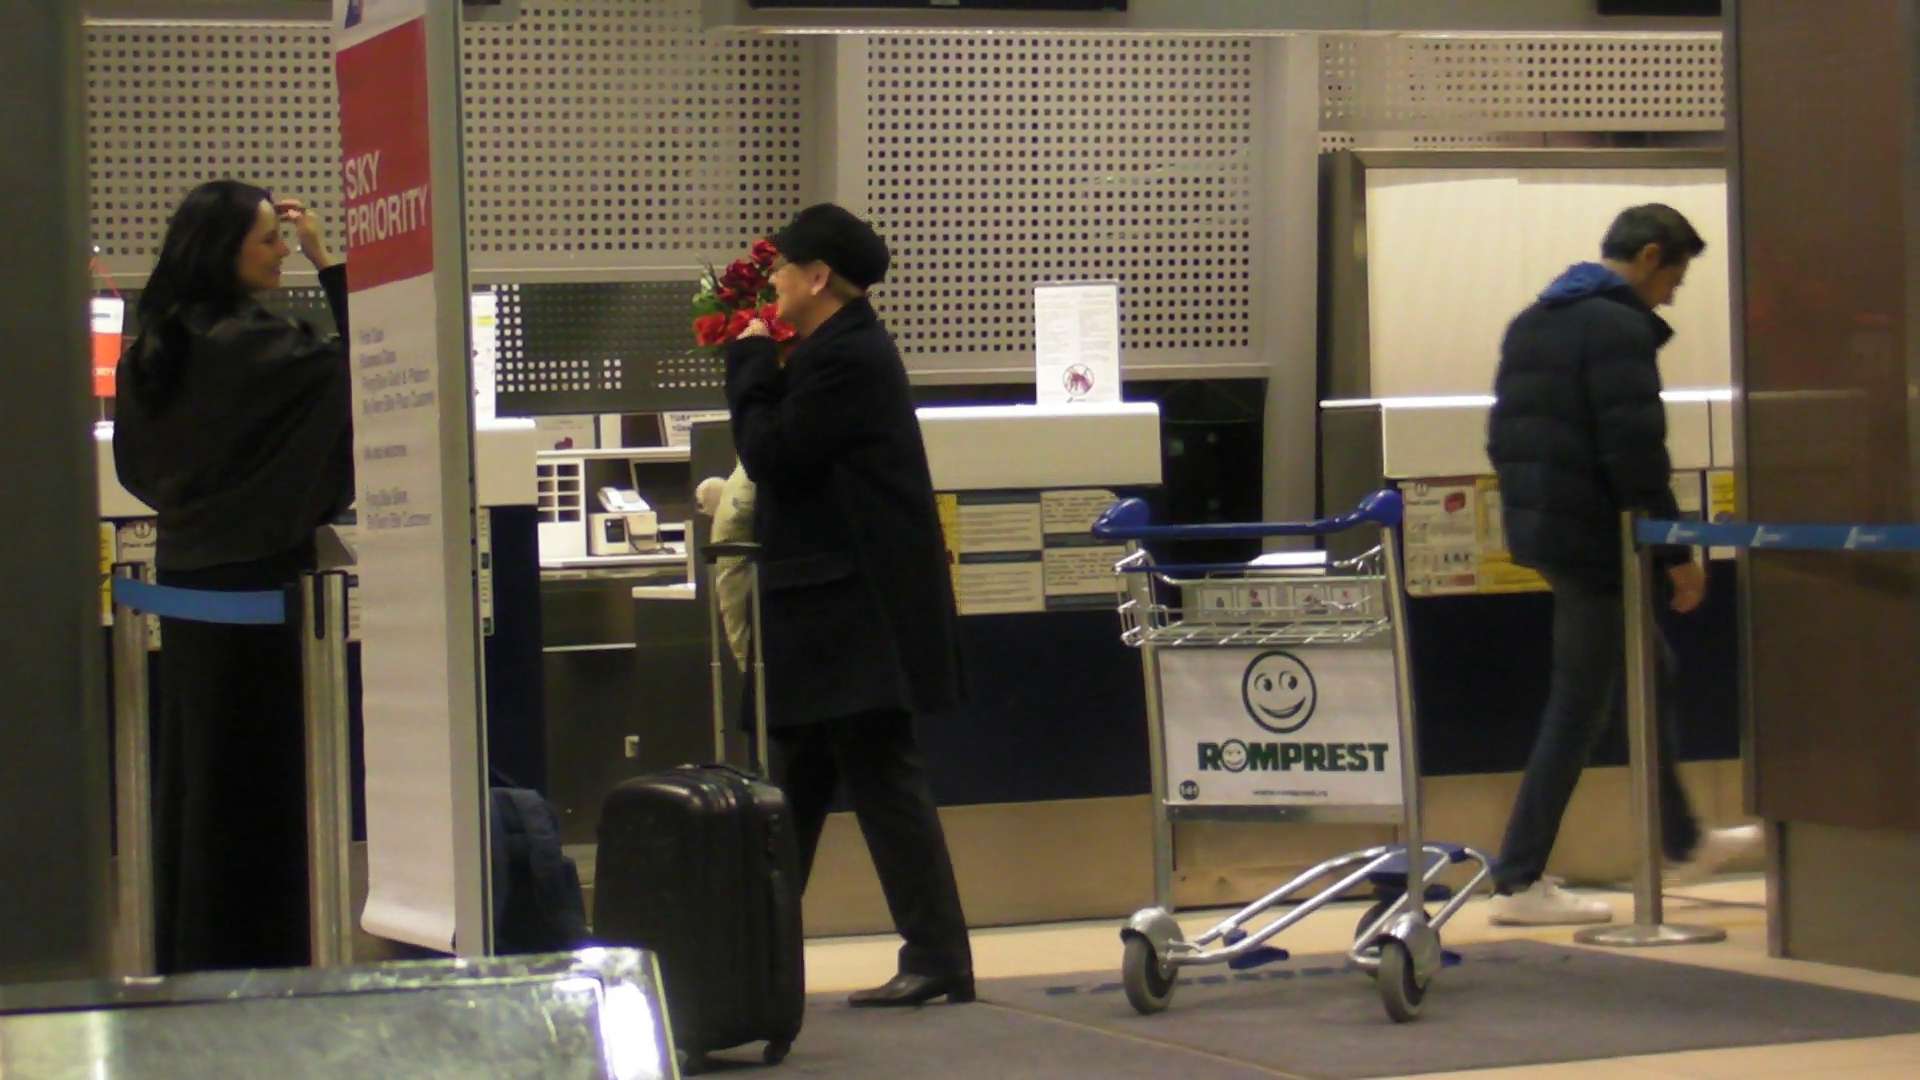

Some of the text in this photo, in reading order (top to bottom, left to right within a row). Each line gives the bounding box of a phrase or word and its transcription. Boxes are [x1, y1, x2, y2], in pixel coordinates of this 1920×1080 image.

[345, 151, 381, 200] SKY
[348, 185, 428, 248] PRIORITY
[1197, 738, 1389, 773] ROMPREST
